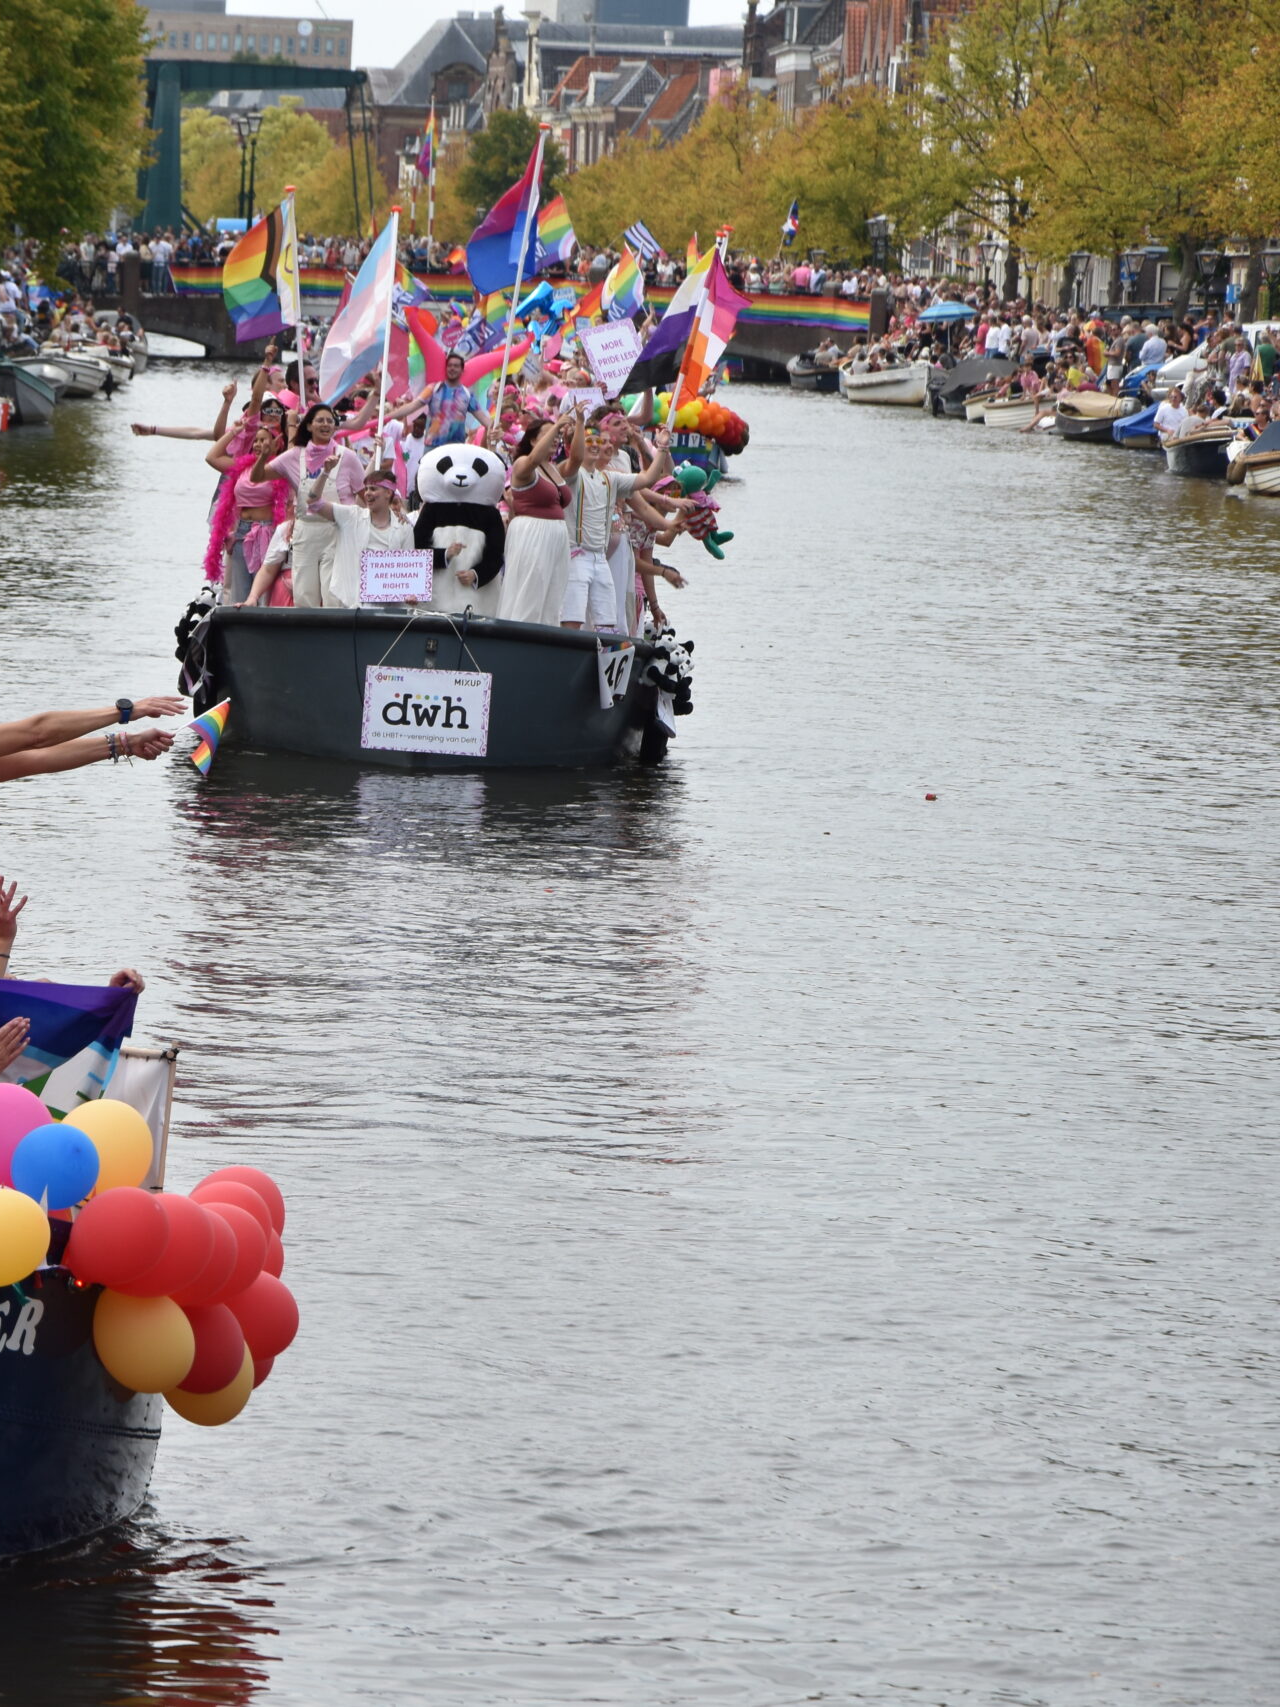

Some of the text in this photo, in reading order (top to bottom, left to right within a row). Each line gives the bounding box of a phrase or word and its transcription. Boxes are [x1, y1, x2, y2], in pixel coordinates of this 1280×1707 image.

[601, 339, 624, 351] MORE
[598, 350, 638, 367] PRIDE LESS
[604, 654, 629, 690] 16
[454, 679, 482, 687] MIXUP
[382, 693, 469, 729] dwh
[460, 736, 477, 744] Delft
